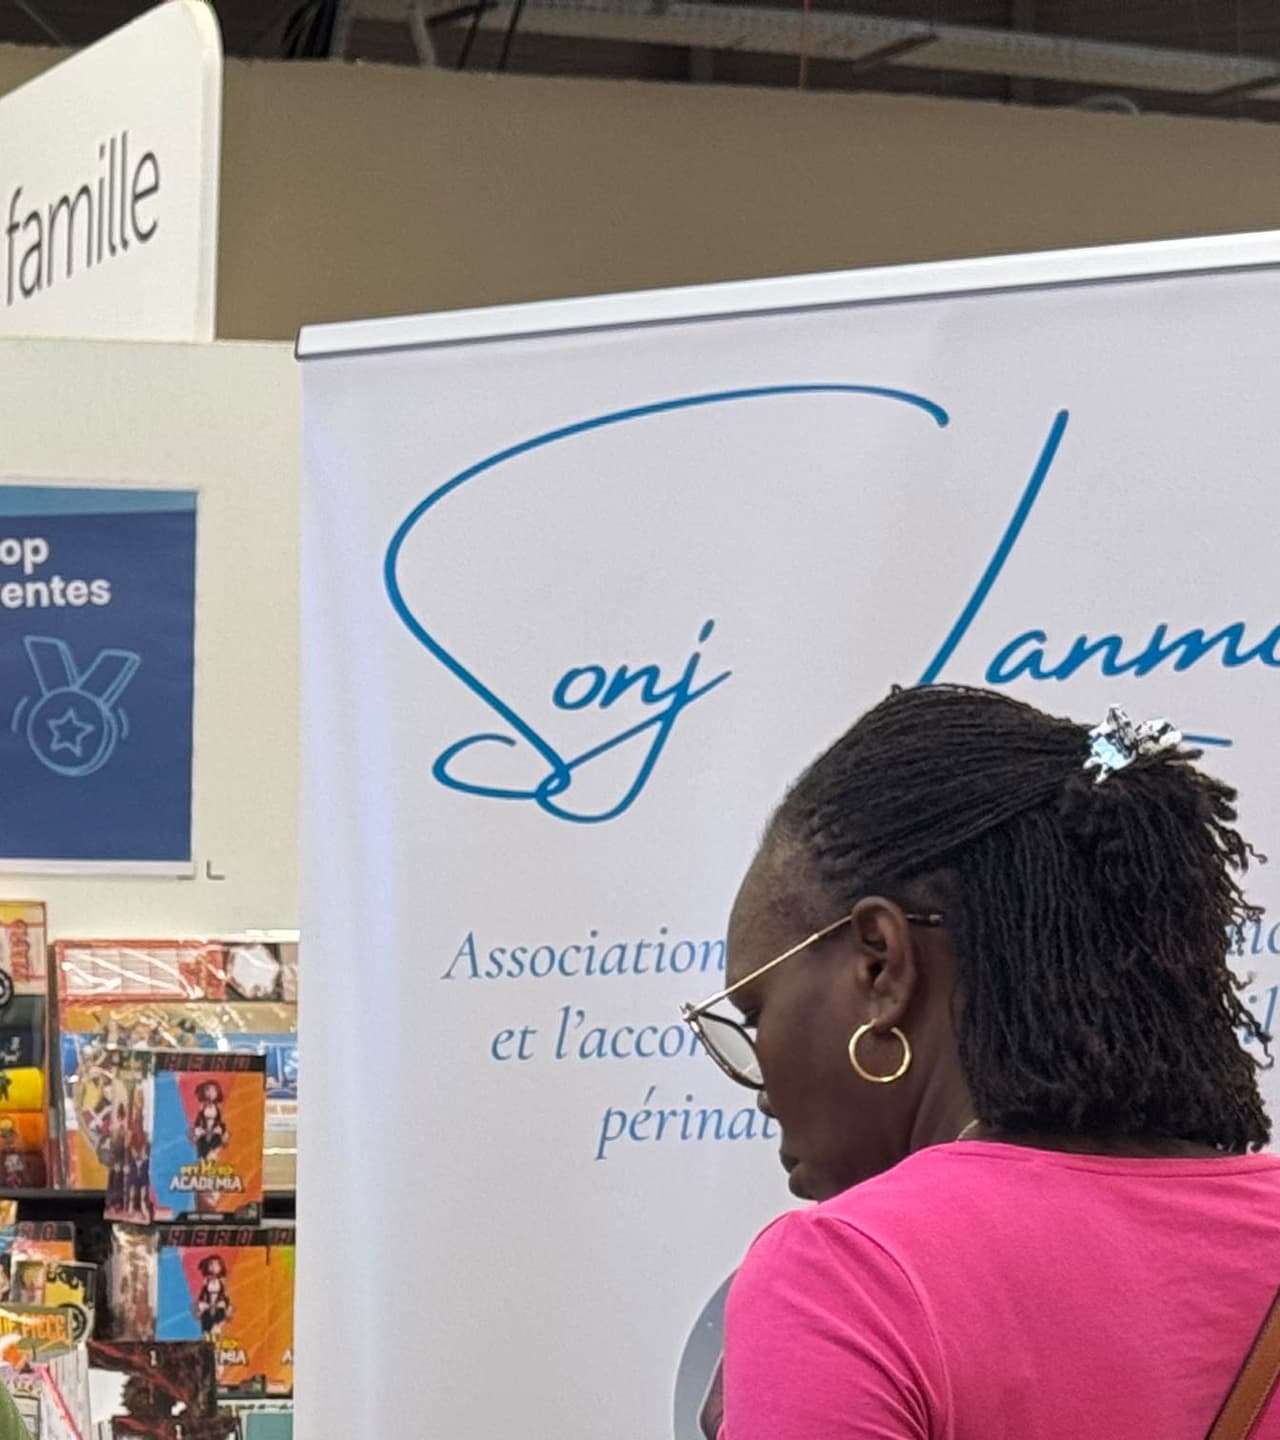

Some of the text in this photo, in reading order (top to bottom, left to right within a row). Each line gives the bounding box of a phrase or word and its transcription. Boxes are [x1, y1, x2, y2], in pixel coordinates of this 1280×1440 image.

[6, 130, 161, 307] famille
[440, 927, 726, 980] Association
[491, 1024, 537, 1060] et
[169, 1175, 243, 1192] ACADEMIA
